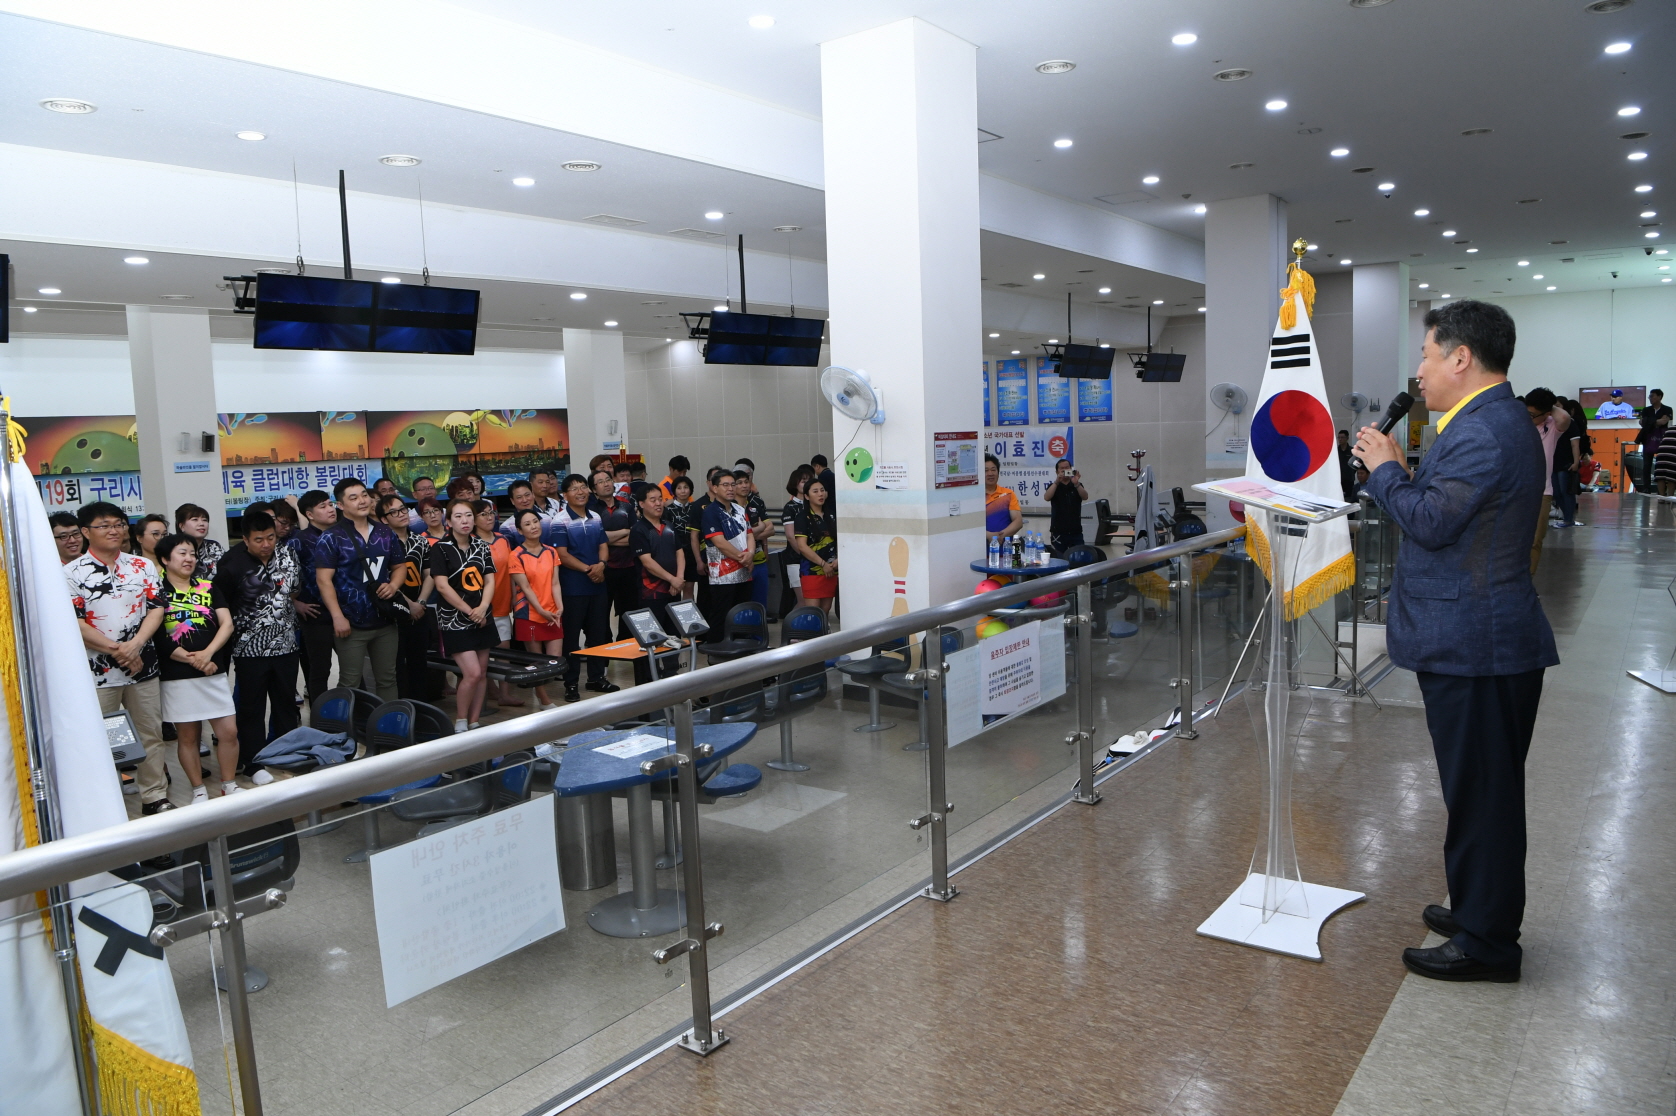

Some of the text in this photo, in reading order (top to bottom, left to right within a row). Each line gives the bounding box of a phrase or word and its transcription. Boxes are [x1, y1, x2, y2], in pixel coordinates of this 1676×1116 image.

[90, 475, 142, 502] 구리시
[251, 466, 310, 493] 클럽대항
[186, 610, 199, 618] Pin
